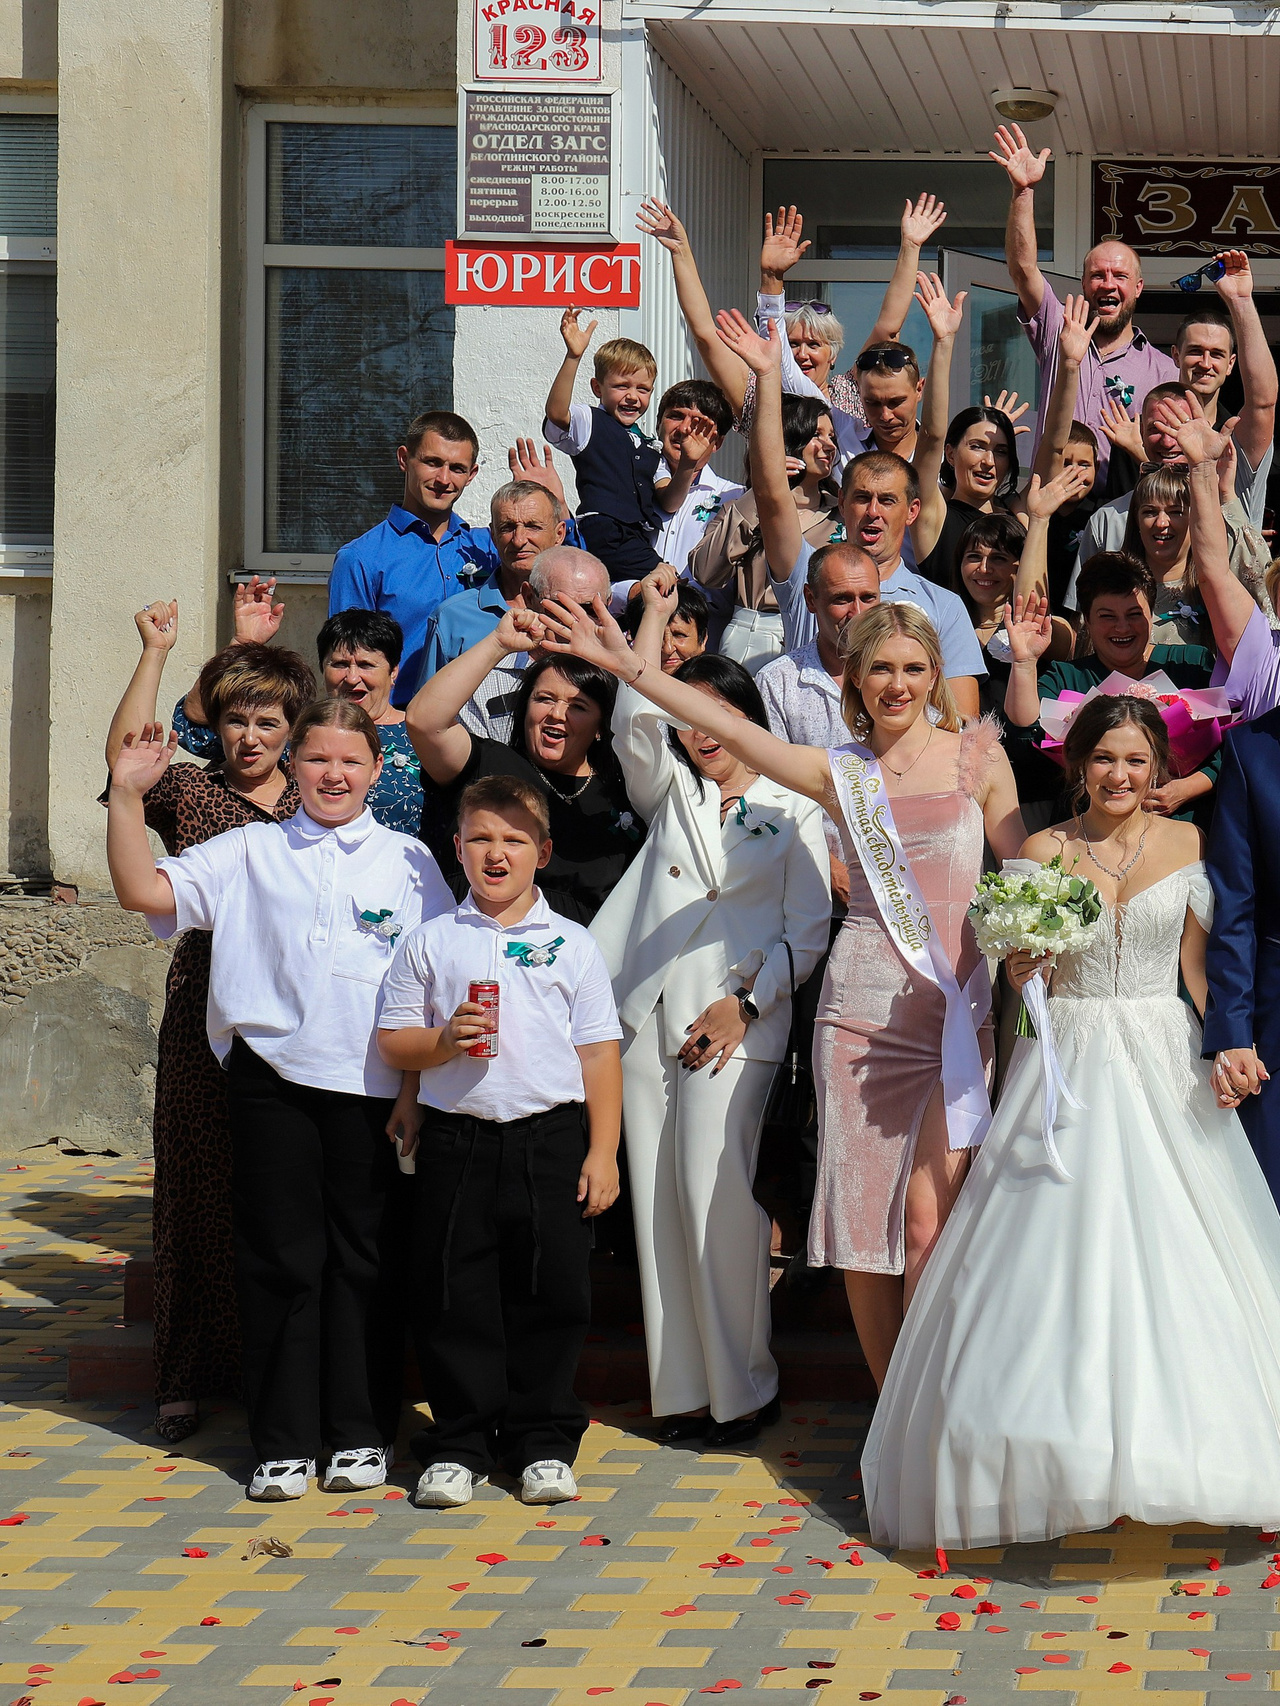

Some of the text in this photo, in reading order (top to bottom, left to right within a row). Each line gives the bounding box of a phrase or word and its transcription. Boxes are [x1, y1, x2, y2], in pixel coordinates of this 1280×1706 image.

[481, 0, 597, 25] КРАСНАЯ
[488, 23, 590, 72] 123
[476, 95, 604, 105] РОССИЙСКАЯ ФЕДЕРАЦИЯ
[469, 104, 611, 114] УПРАВЛЕНИЕ ЗАПИСИ АКТОВ
[469, 113, 611, 124] ГРАЖДАНСКОГО СОСТОЯНИЯ
[480, 123, 600, 133] КРАСНОДАРСКОГО КРАЯ
[472, 133, 607, 153] ОТДЕЛ ЗАГС
[470, 152, 610, 164] БЕЛОГЛИНСКОГО РАЙОНА
[501, 164, 578, 173] РЕЖИМ РАБОТЫ
[469, 176, 600, 186] ежедневно 8.00-17.00
[469, 186, 600, 197] пятница 8.00-16.00
[469, 198, 602, 209] перерыв 12.00-12.50
[468, 213, 525, 224] выходной
[534, 210, 605, 220] воскресенье
[534, 219, 606, 229] понедельник
[456, 252, 641, 294] ЮРИСТ
[840, 754, 924, 952] Почетная свидетельница
